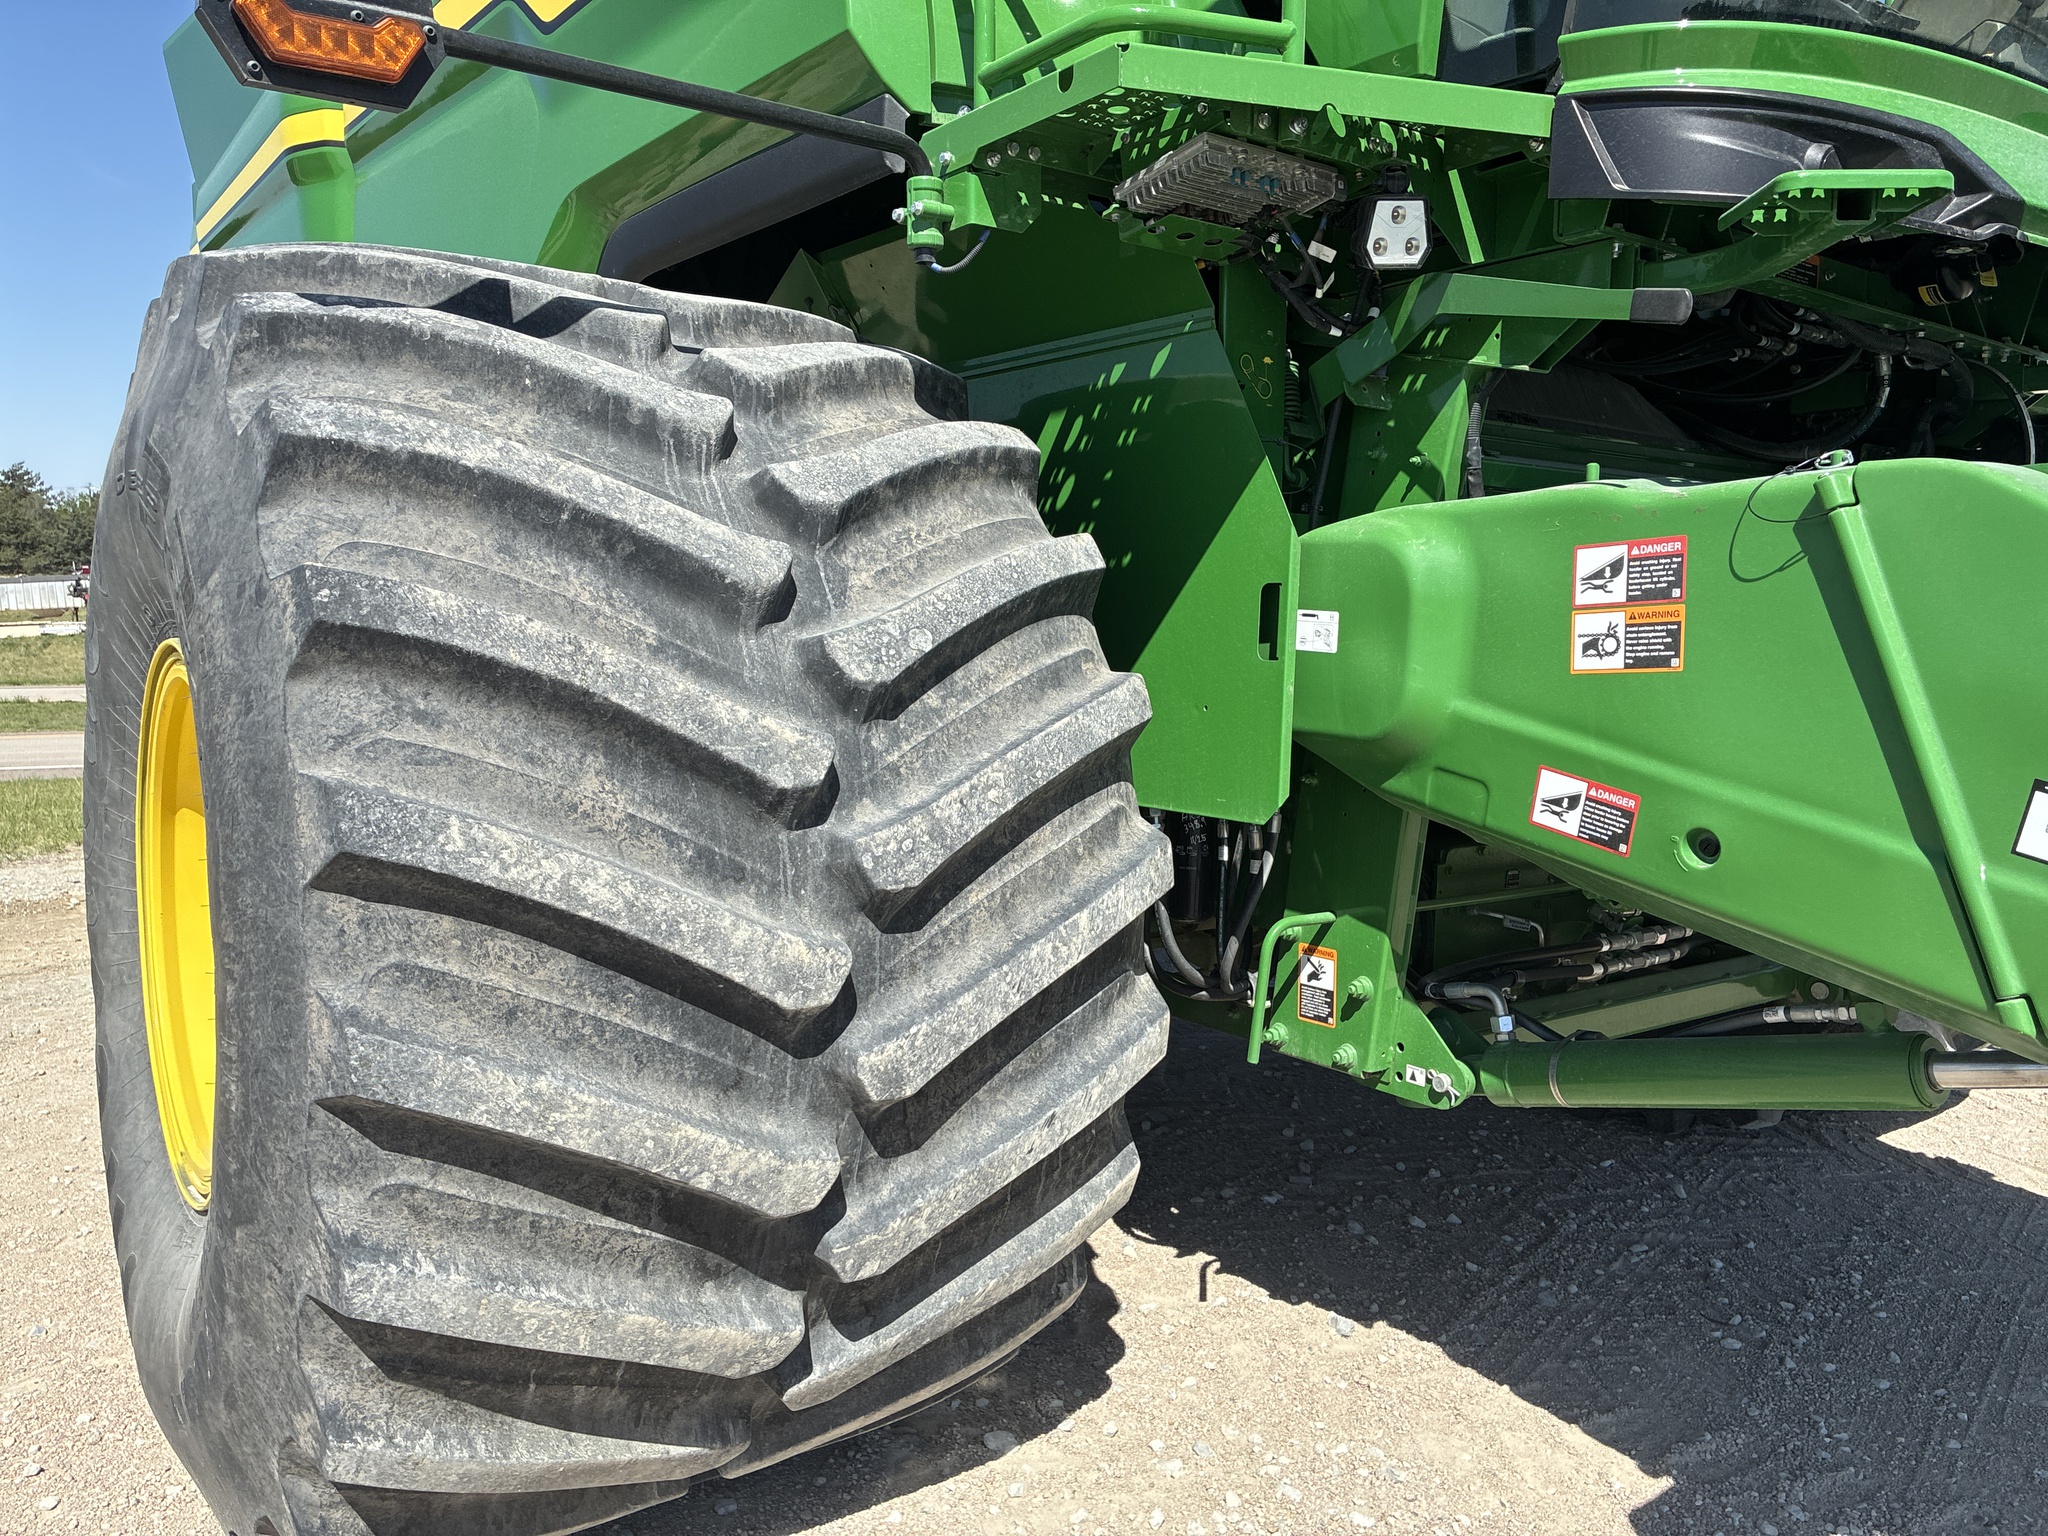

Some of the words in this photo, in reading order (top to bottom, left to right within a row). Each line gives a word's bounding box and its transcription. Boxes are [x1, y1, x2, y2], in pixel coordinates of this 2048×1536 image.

[1640, 542, 1681, 554] DANGER
[1637, 610, 1680, 619] WARNING
[1597, 790, 1636, 809] DANGER
[1308, 946, 1334, 958] WARNING
